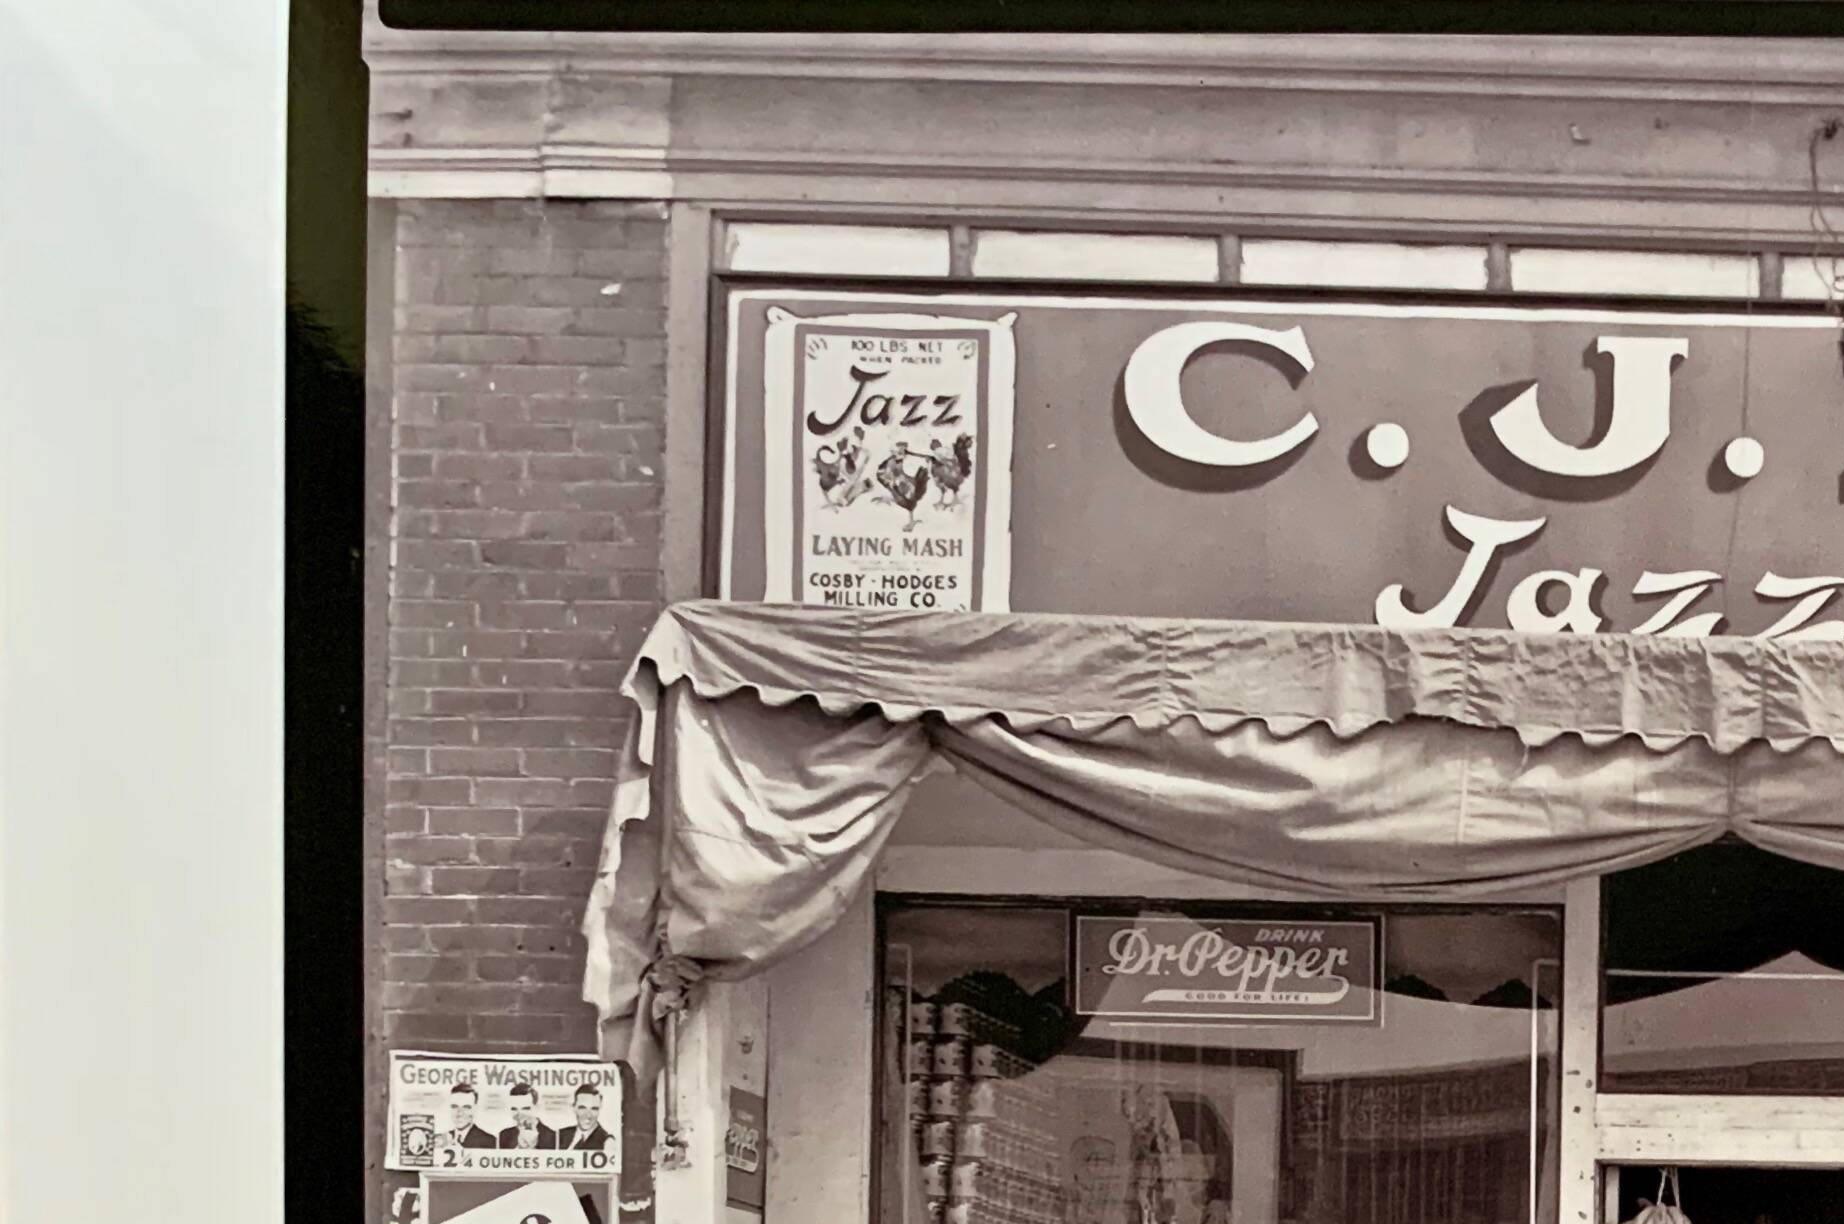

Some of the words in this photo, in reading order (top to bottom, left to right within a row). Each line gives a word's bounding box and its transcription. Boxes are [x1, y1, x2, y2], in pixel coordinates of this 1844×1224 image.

[880, 340, 907, 352] LBS
[919, 341, 942, 352] NET
[807, 364, 962, 435] Jazz
[812, 535, 891, 557] LAYING
[902, 537, 963, 557] MASH
[824, 590, 898, 606] MILLING
[1254, 929, 1326, 942] DRINK
[1186, 992, 1227, 1000] GOOD
[1234, 992, 1262, 1000] FOR
[401, 1063, 478, 1085] GEORGE
[485, 1064, 616, 1087] WASHINGTON
[479, 1156, 540, 1169] OUNCES
[546, 1158, 575, 1169] FOR
